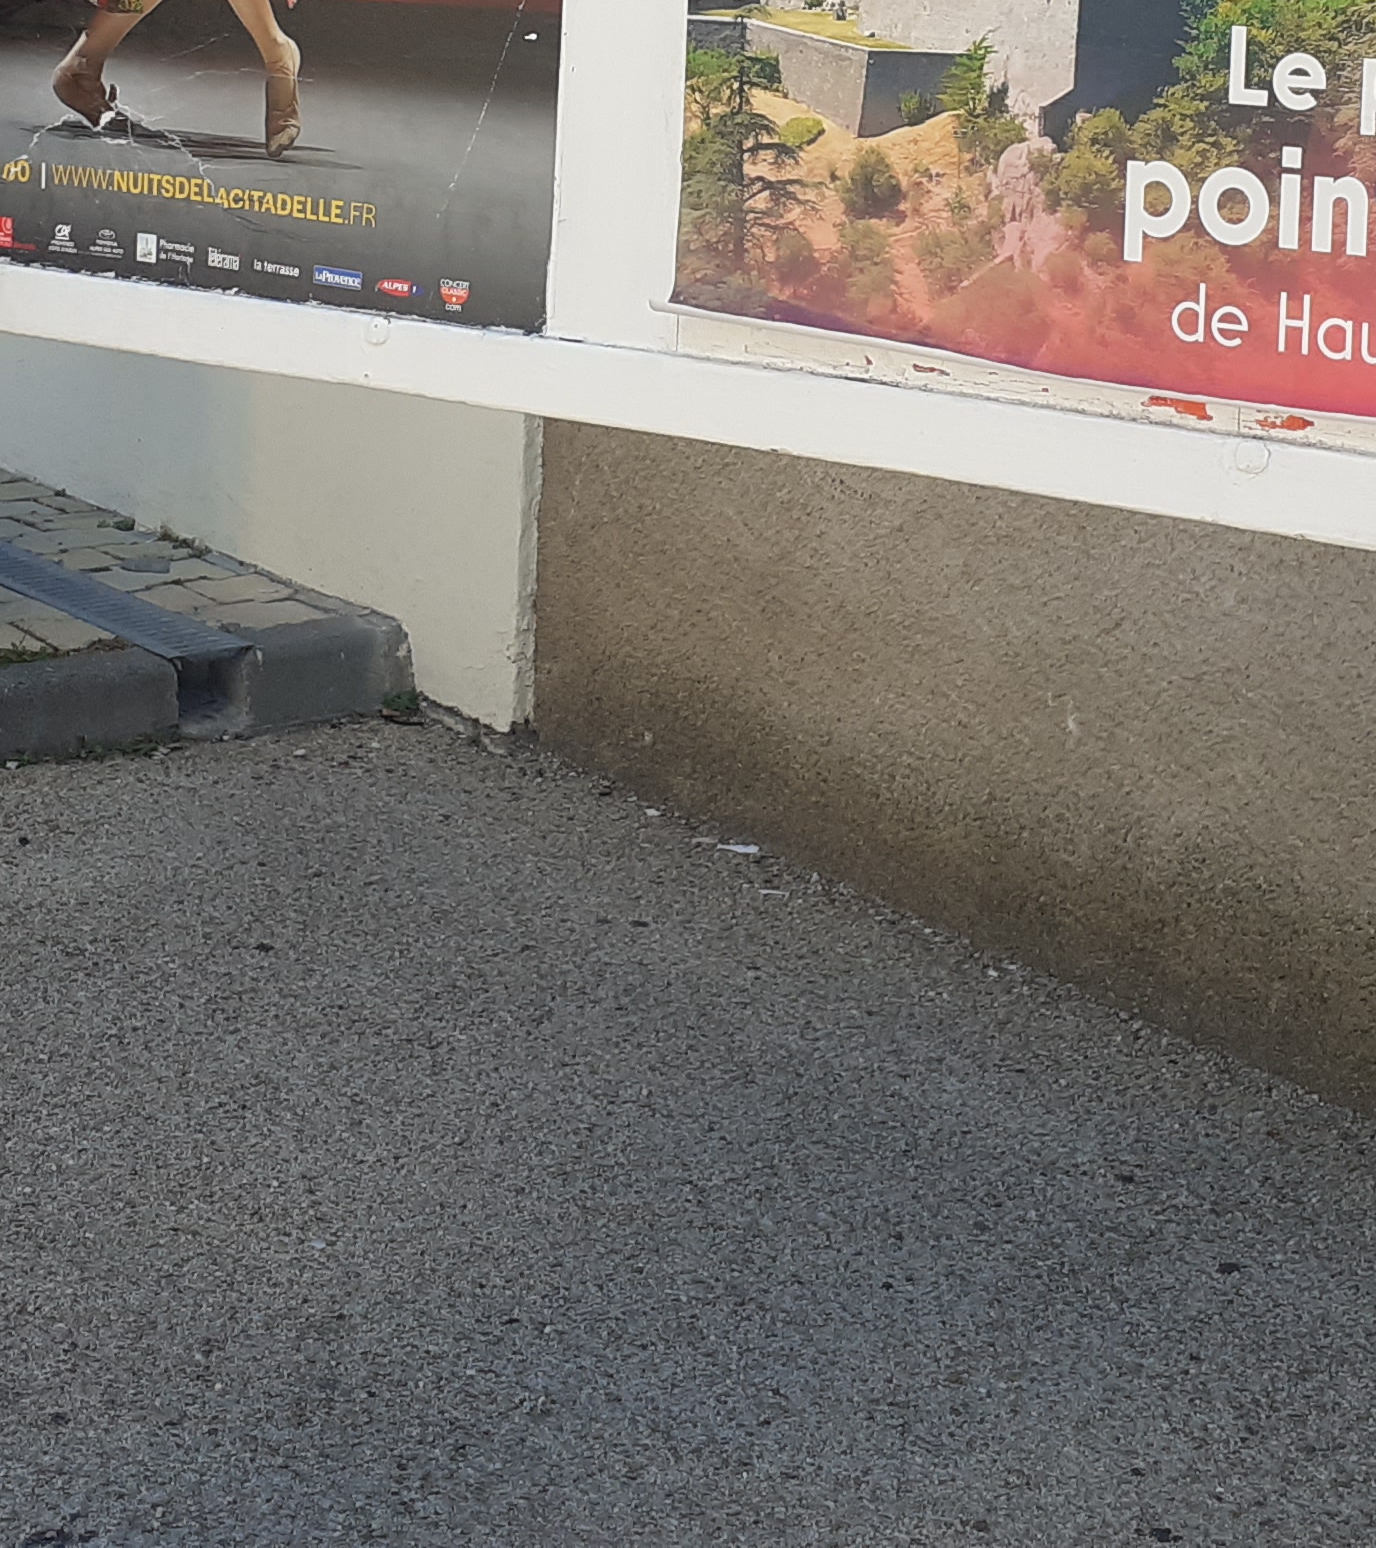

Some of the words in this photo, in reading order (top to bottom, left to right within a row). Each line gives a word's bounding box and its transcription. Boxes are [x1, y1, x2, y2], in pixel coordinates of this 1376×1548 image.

[1227, 25, 1327, 110] Le
[253, 259, 262, 270] la
[264, 261, 300, 277] terrasse
[381, 281, 409, 292] ALPES
[1171, 283, 1248, 348] de
